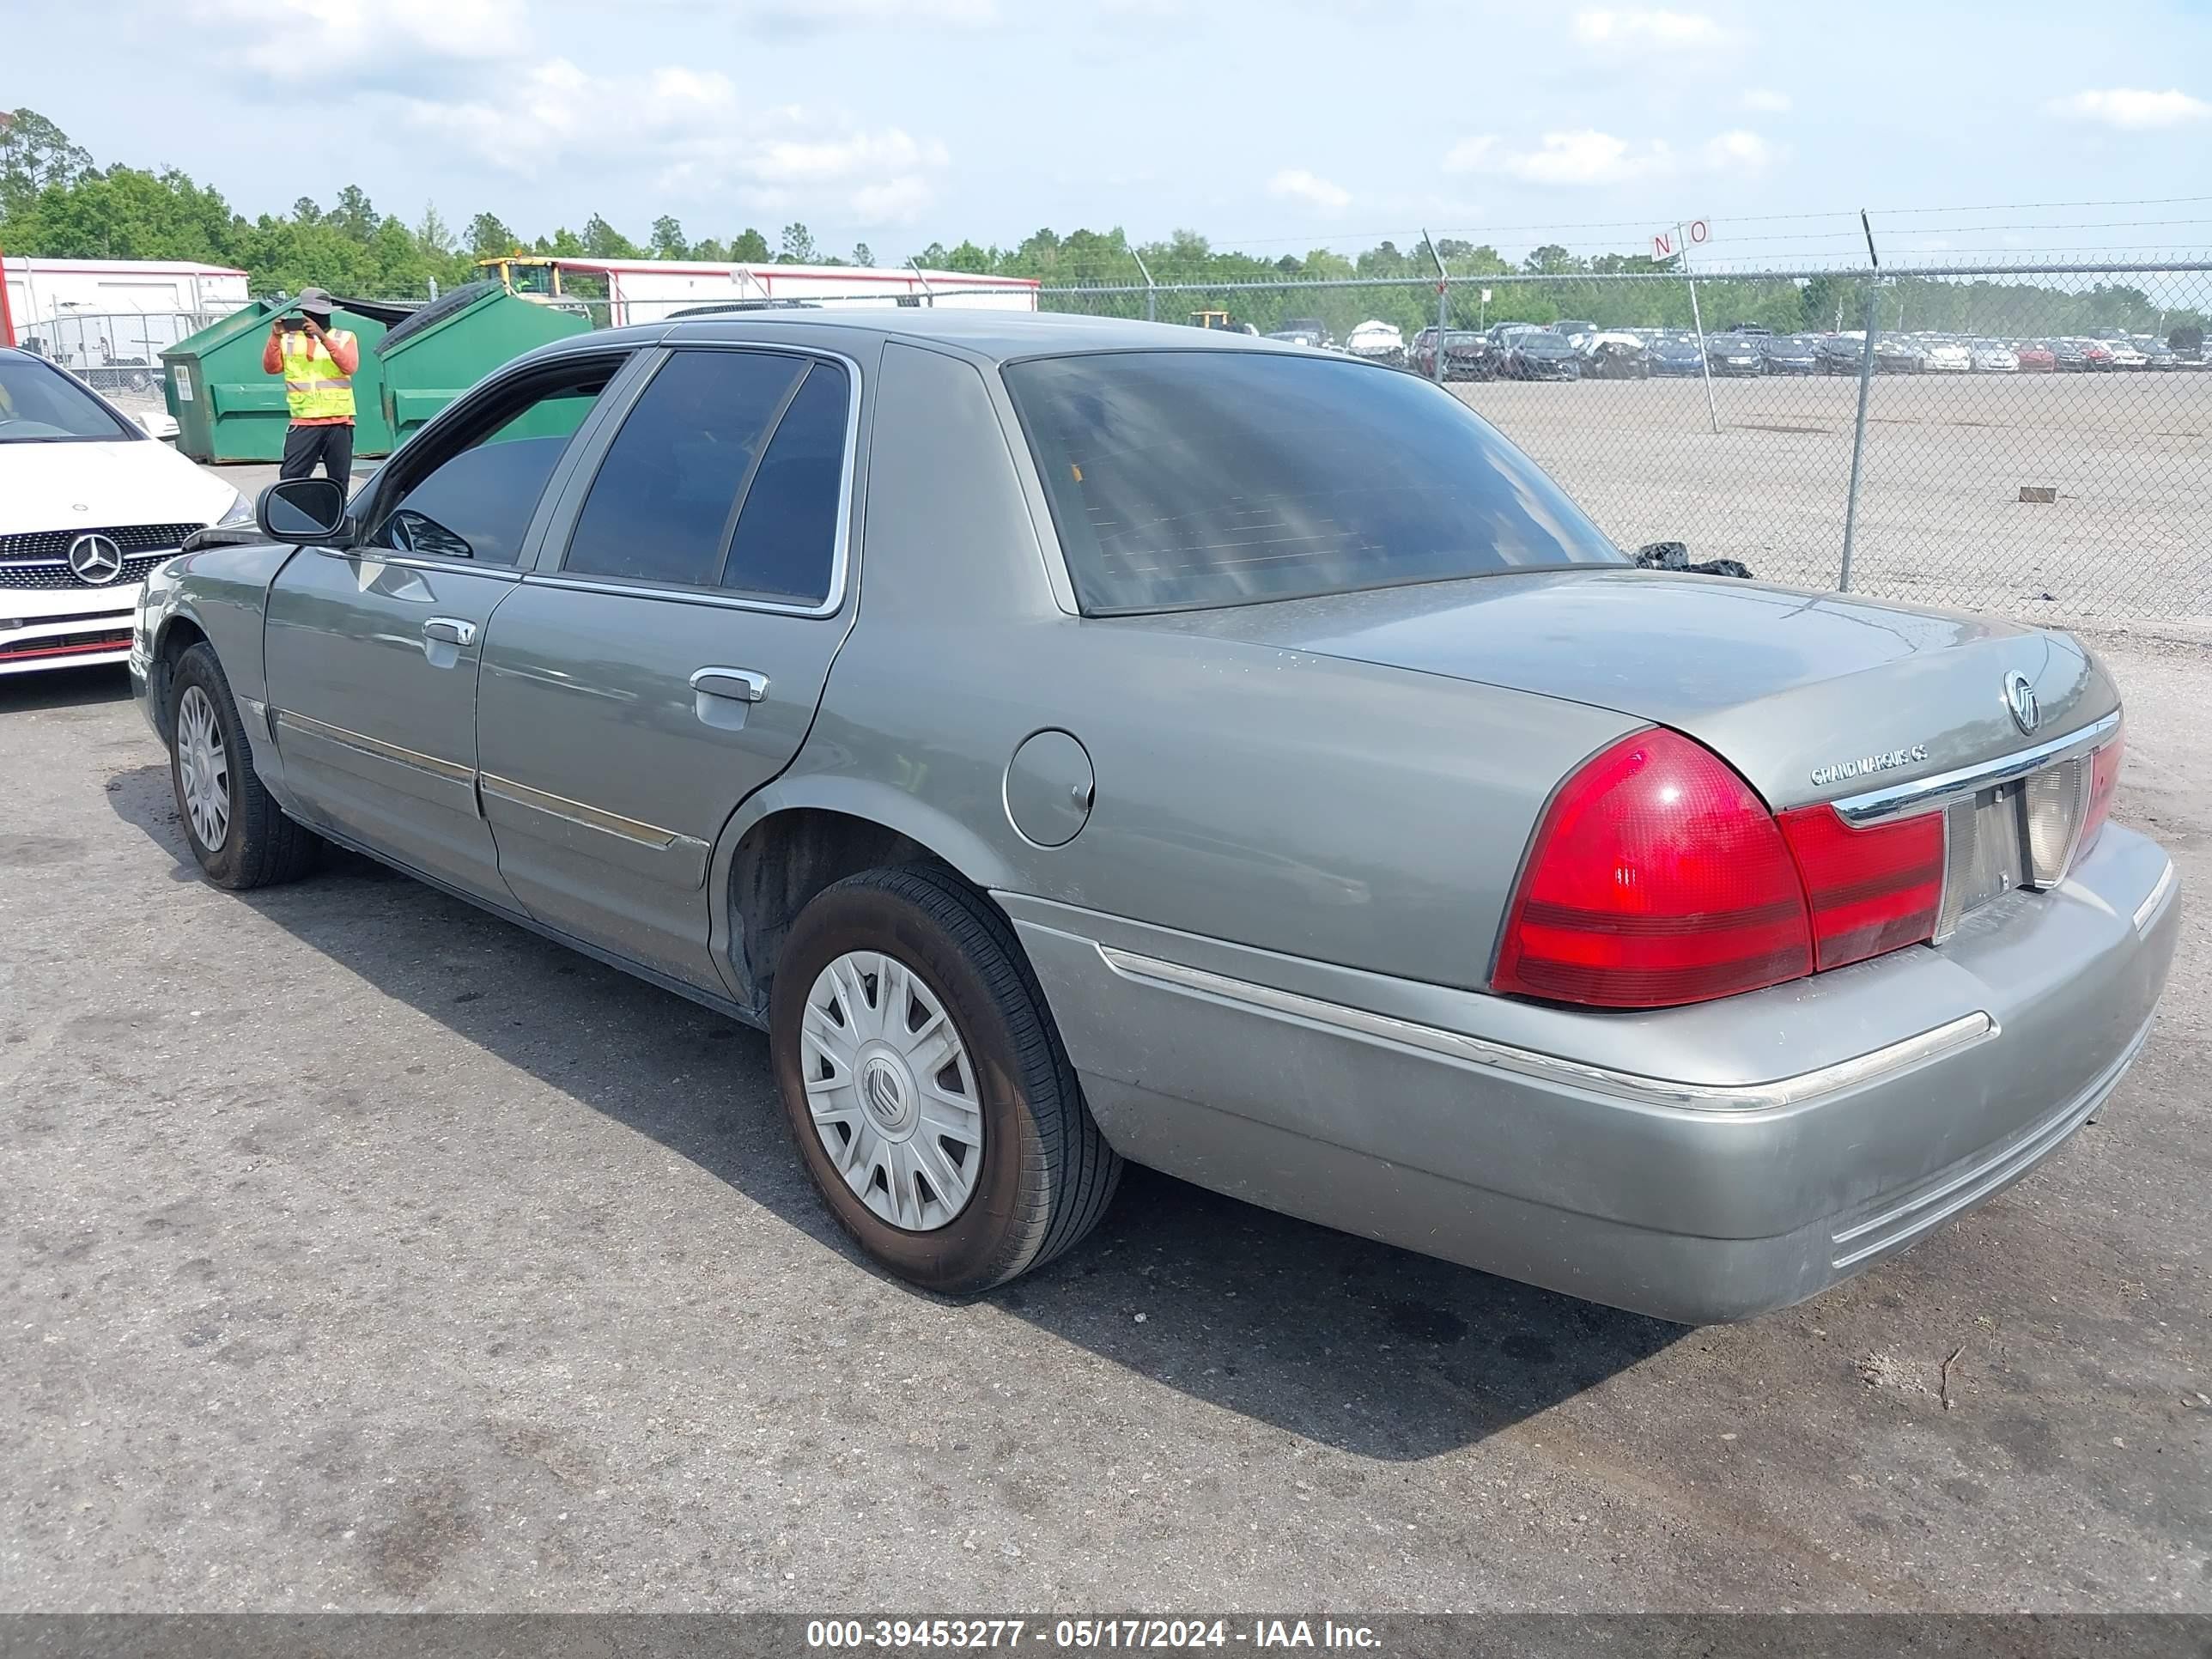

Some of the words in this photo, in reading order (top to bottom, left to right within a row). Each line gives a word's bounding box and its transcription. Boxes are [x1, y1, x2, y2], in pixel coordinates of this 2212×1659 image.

[1655, 233, 1670, 257] N
[1691, 221, 1706, 243] O
[1810, 762, 1856, 787] GRAND
[1855, 748, 1910, 776] MARQUIS
[1910, 744, 1929, 763] GS
